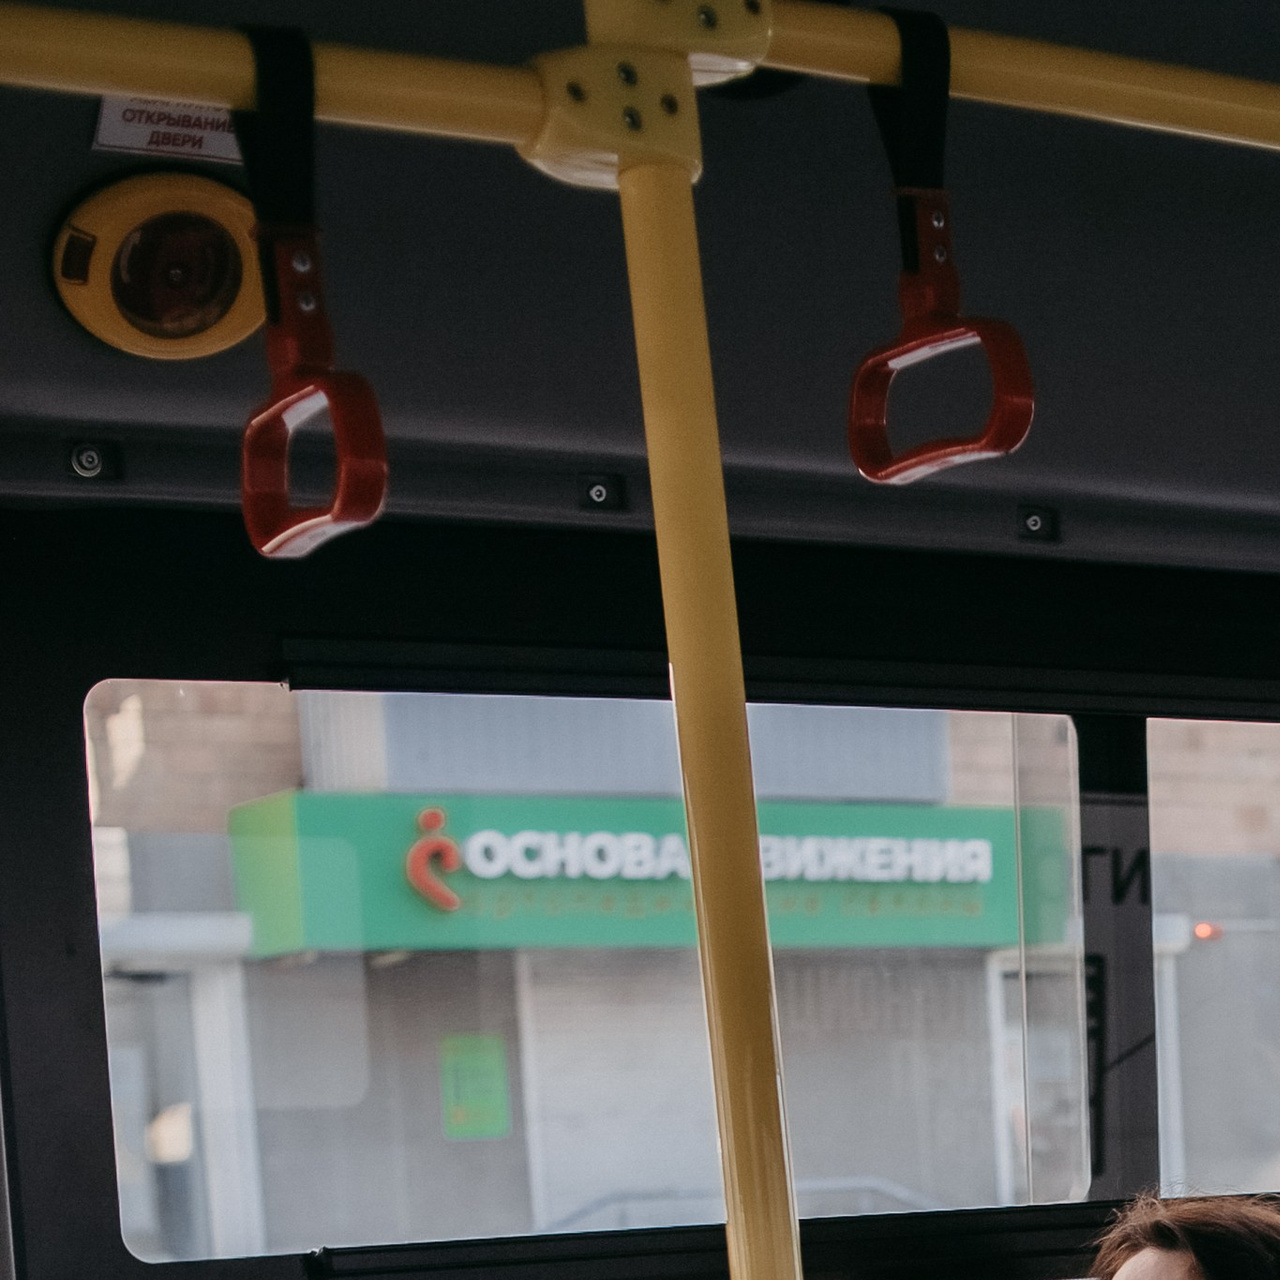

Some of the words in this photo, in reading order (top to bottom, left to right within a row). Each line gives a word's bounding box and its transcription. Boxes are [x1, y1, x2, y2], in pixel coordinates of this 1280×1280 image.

[147, 130, 204, 149] ДВЕРИ
[464, 829, 692, 880] ОСНОВА
[758, 834, 992, 883] ВИЖЕНИЯ
